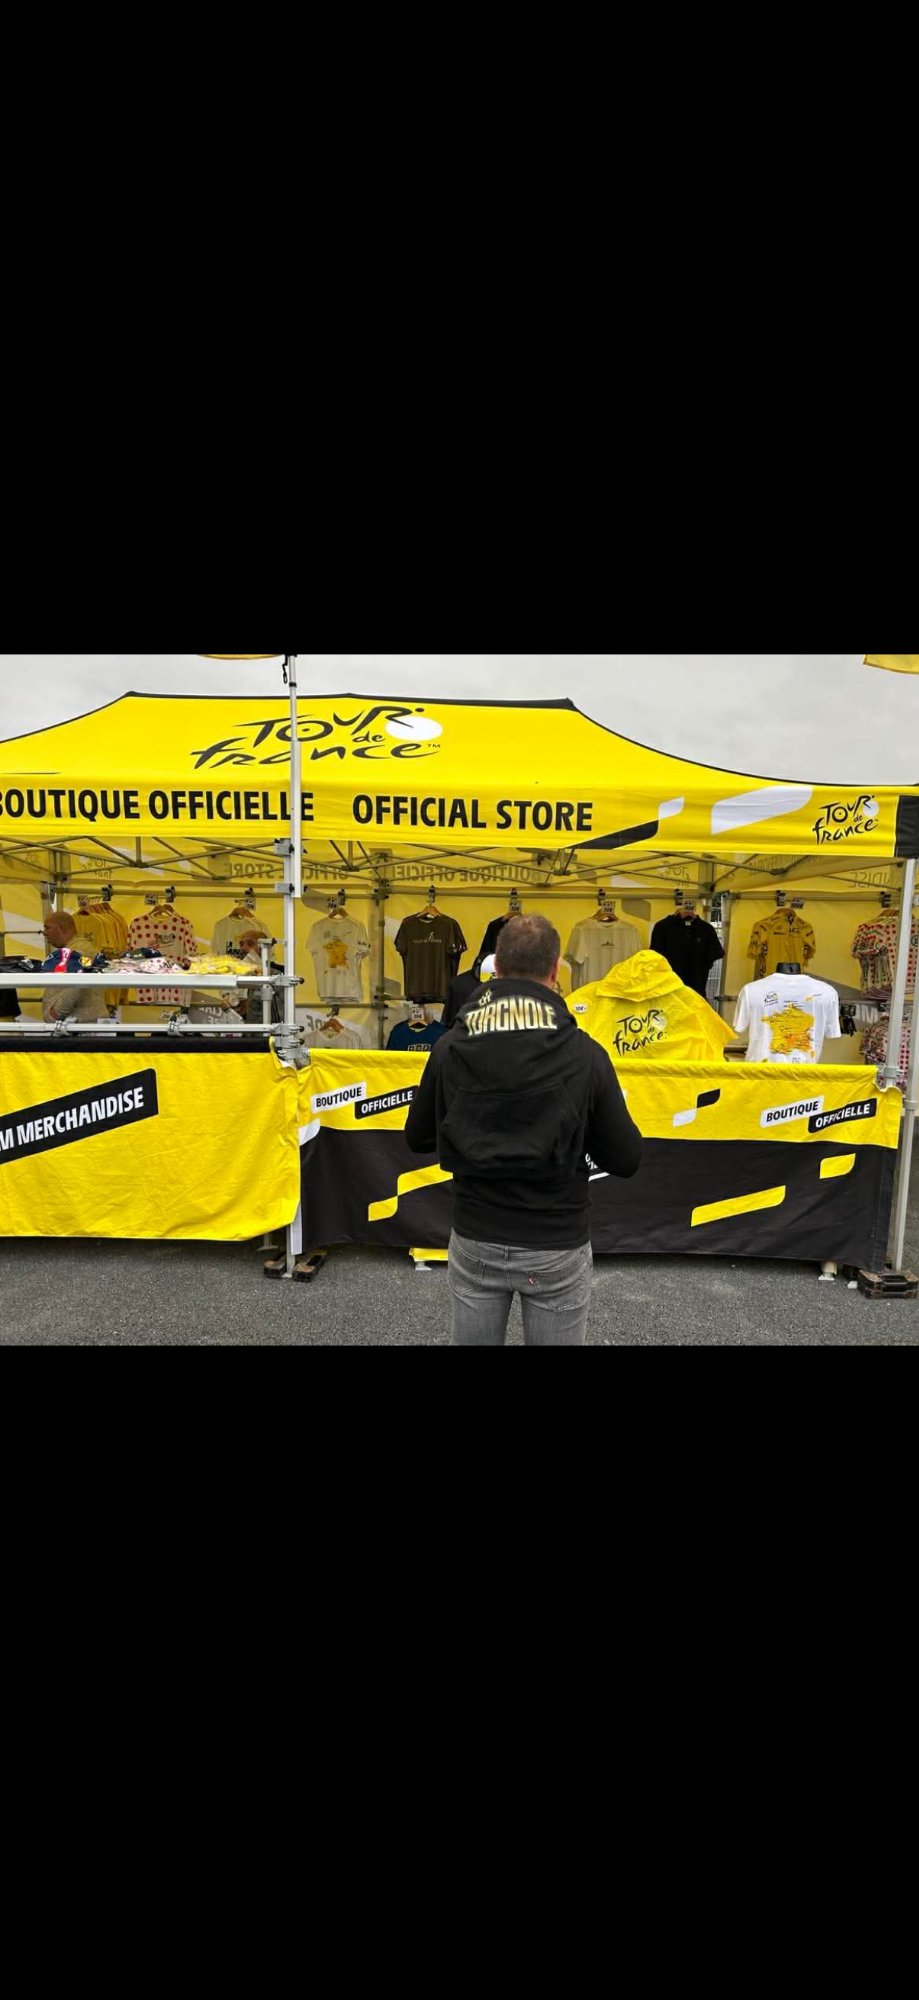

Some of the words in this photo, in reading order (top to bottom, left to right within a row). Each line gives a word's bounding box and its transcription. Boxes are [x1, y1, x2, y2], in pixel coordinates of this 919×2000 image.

[352, 731, 386, 743] de
[0, 789, 141, 822] OUTIQUE
[149, 790, 314, 822] OFFICIELLE
[352, 794, 486, 829] OFFICIAL
[496, 799, 593, 831] STORE
[820, 794, 876, 827] TOUR
[812, 816, 878, 845] france
[616, 1009, 663, 1035] TOUR
[613, 1030, 664, 1056] france
[315, 1086, 362, 1108] BOUTIQUE
[361, 1090, 413, 1114] OFFICIELLE
[16, 1086, 144, 1145] MERCHANDISE
[766, 1101, 819, 1122] BOUTIQUE
[815, 1103, 871, 1128] OFFICIELLE
